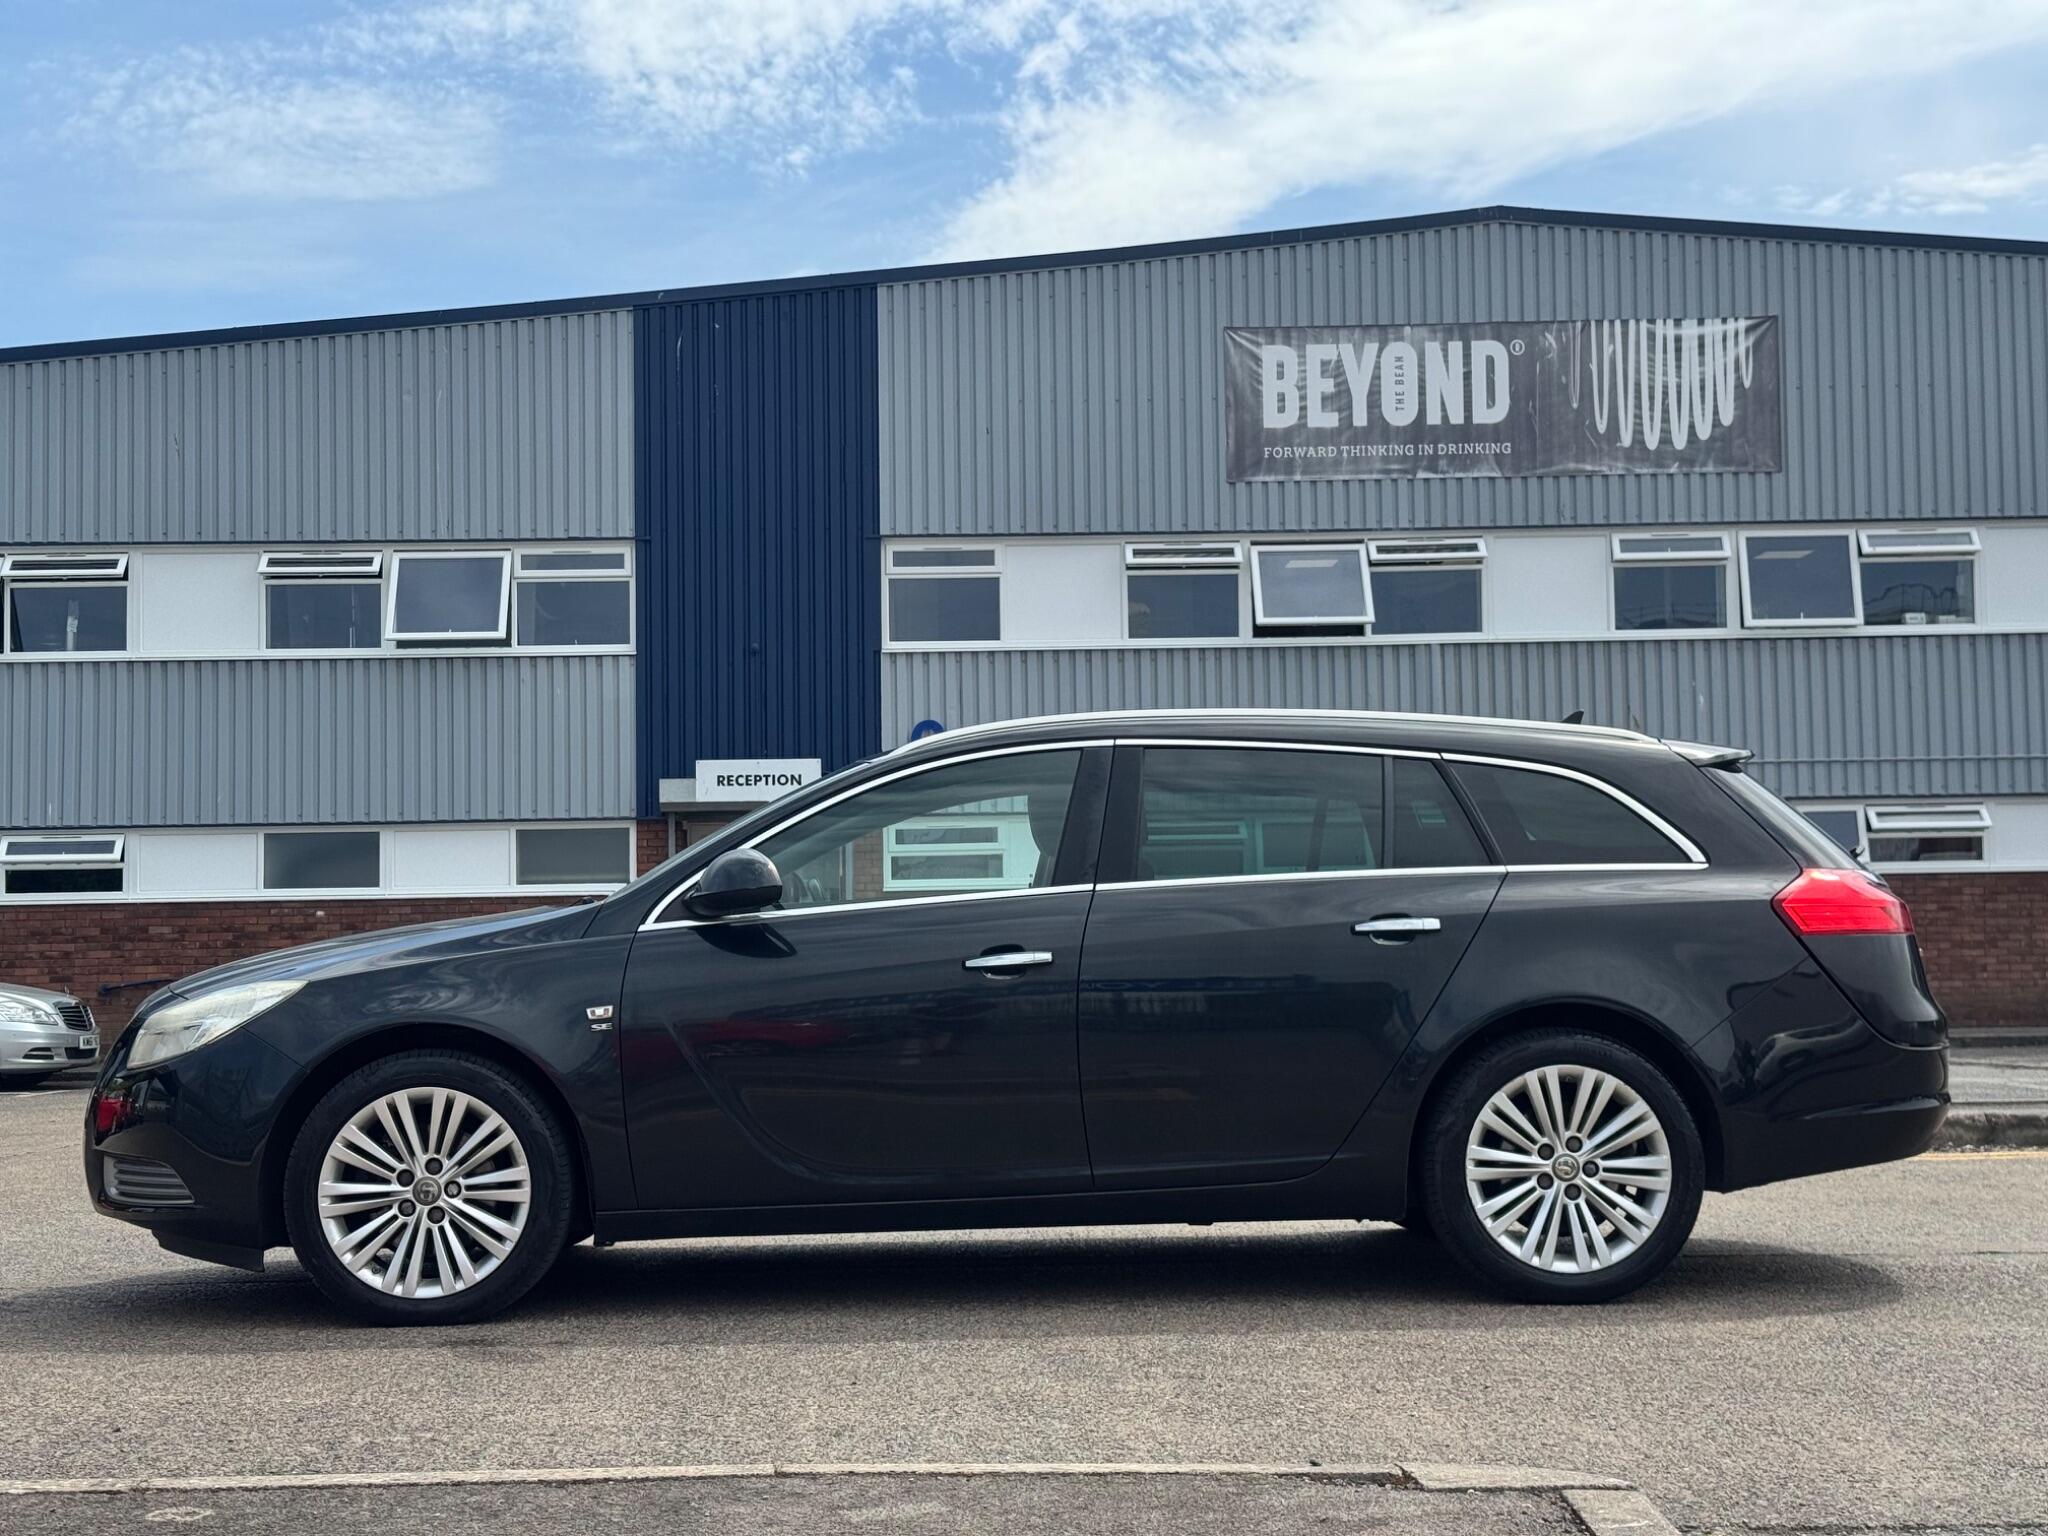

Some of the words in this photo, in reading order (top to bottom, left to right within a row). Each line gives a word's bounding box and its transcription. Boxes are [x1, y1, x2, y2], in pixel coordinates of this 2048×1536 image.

[1394, 355, 1405, 386] BEAN
[1262, 340, 1511, 428] BEYOND
[1394, 391, 1405, 412] THE
[1264, 446, 1337, 459] FORWARD
[1340, 444, 1414, 457] THINKING
[1418, 443, 1434, 456] IN
[1437, 442, 1512, 456] DRINKING
[716, 773, 802, 787] RECEPTION
[590, 1022, 613, 1032] SE
